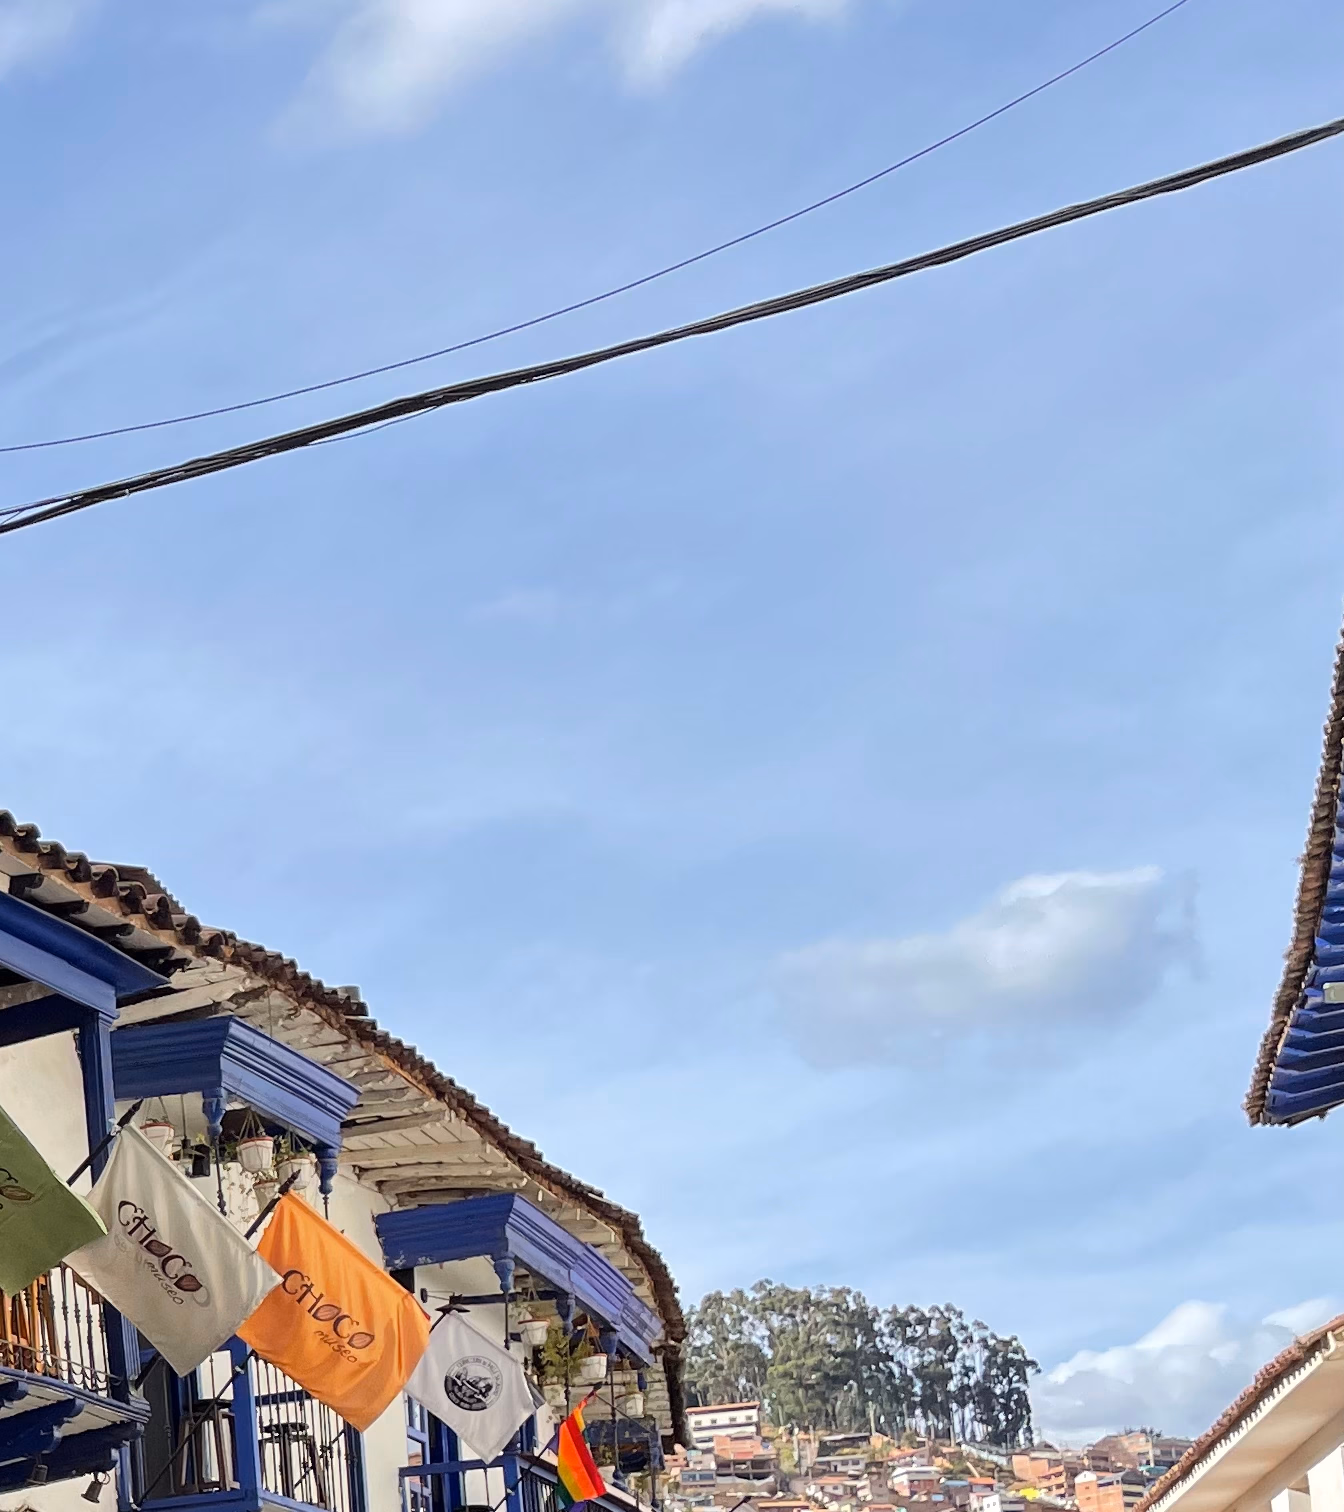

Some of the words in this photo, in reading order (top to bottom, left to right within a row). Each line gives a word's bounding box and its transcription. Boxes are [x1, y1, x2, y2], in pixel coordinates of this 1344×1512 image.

[118, 1200, 204, 1293] CHOCO
[144, 1259, 185, 1306] museo
[282, 1269, 375, 1350] CHOCO
[313, 1330, 358, 1364] museo
